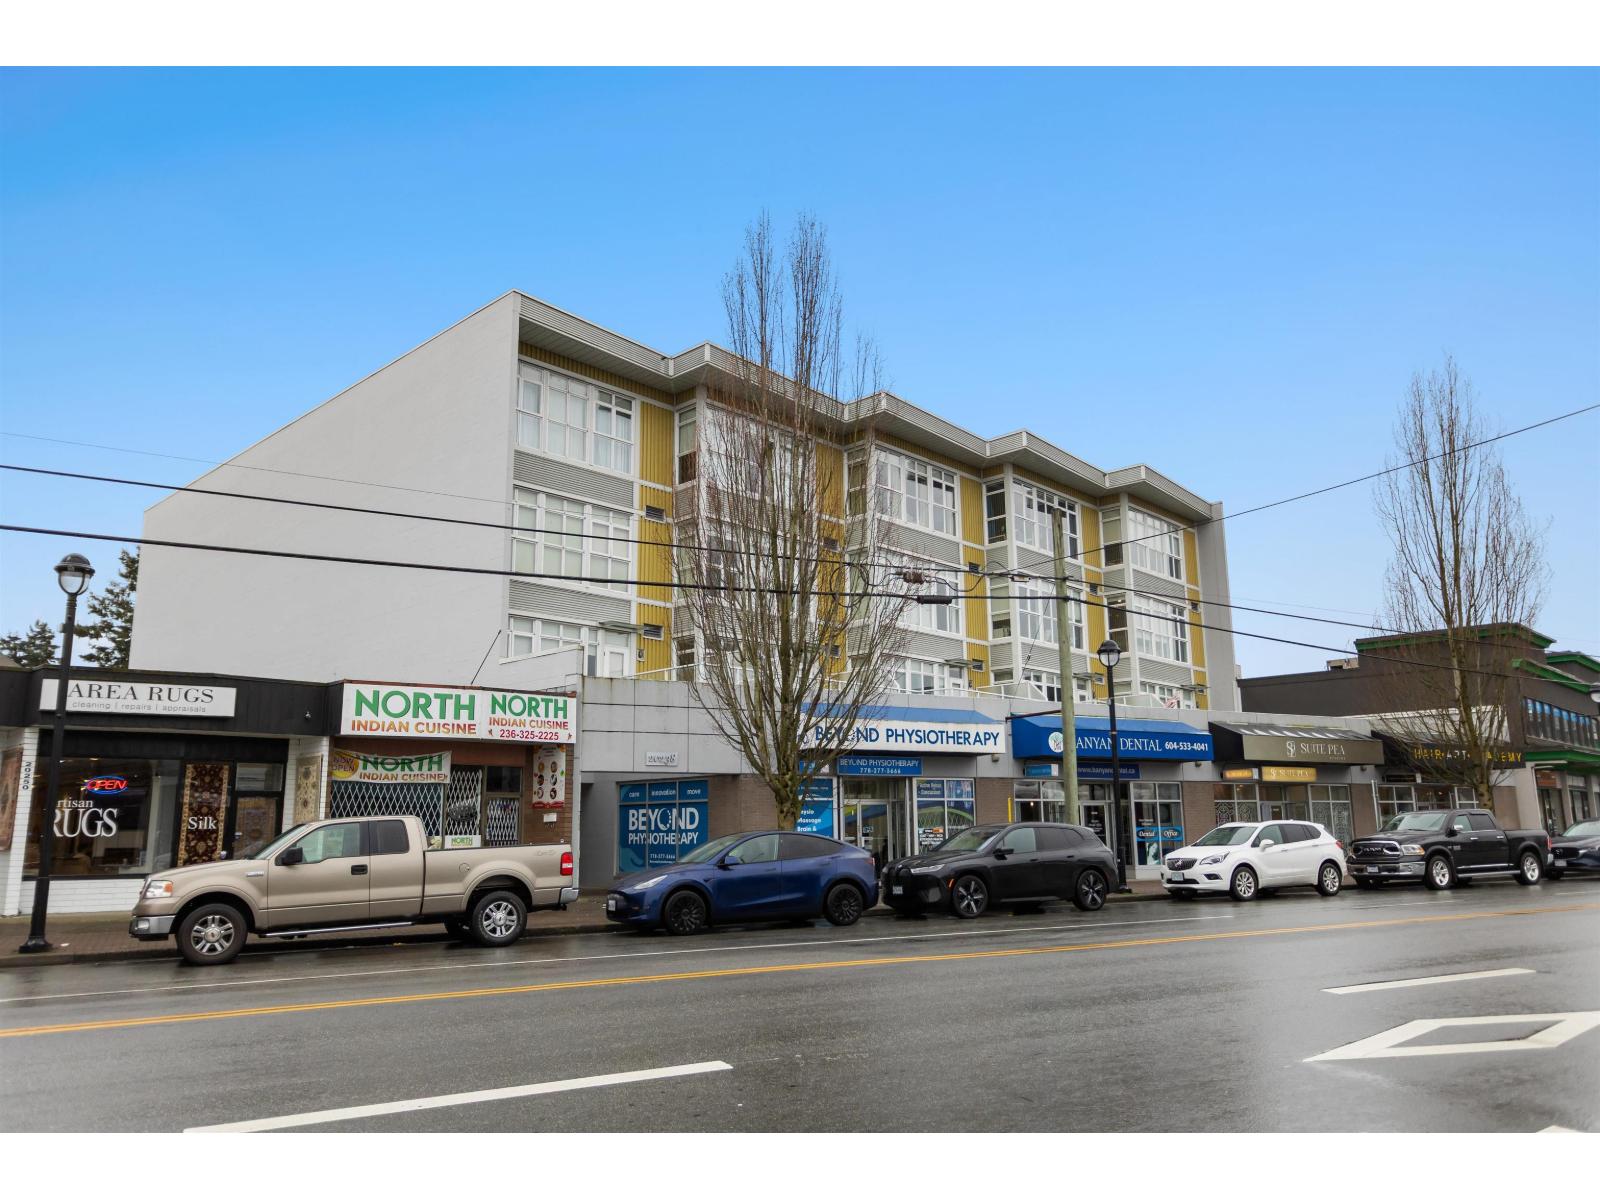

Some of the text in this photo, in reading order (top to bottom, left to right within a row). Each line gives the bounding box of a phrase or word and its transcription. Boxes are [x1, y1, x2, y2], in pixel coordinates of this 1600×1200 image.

[67, 683, 214, 704] AREA RUGS
[71, 701, 206, 713] cleaning repairs appraisals
[354, 689, 475, 720] NORTH
[490, 693, 568, 720] NORTH
[351, 719, 477, 735] INDIAN CUISINE
[489, 716, 569, 731] INDIAN CUISINE
[499, 728, 559, 741] 236-325-2225
[886, 728, 1000, 746] PHYSIOTHERAPY
[1119, 738, 1163, 752] DENTAL
[1164, 740, 1208, 752] 604-533-4041
[1300, 742, 1327, 754] SUITE
[1328, 744, 1346, 755] PEA
[361, 754, 443, 772] NORTH
[840, 759, 920, 768] BEYOND PHYSIOTHERAPY
[359, 773, 400, 781] INDIAN
[88, 780, 128, 790] OPEN
[56, 797, 93, 808] rtisan
[187, 815, 217, 830] Silk
[628, 807, 700, 831] BEYOND
[1163, 830, 1178, 839] Office
